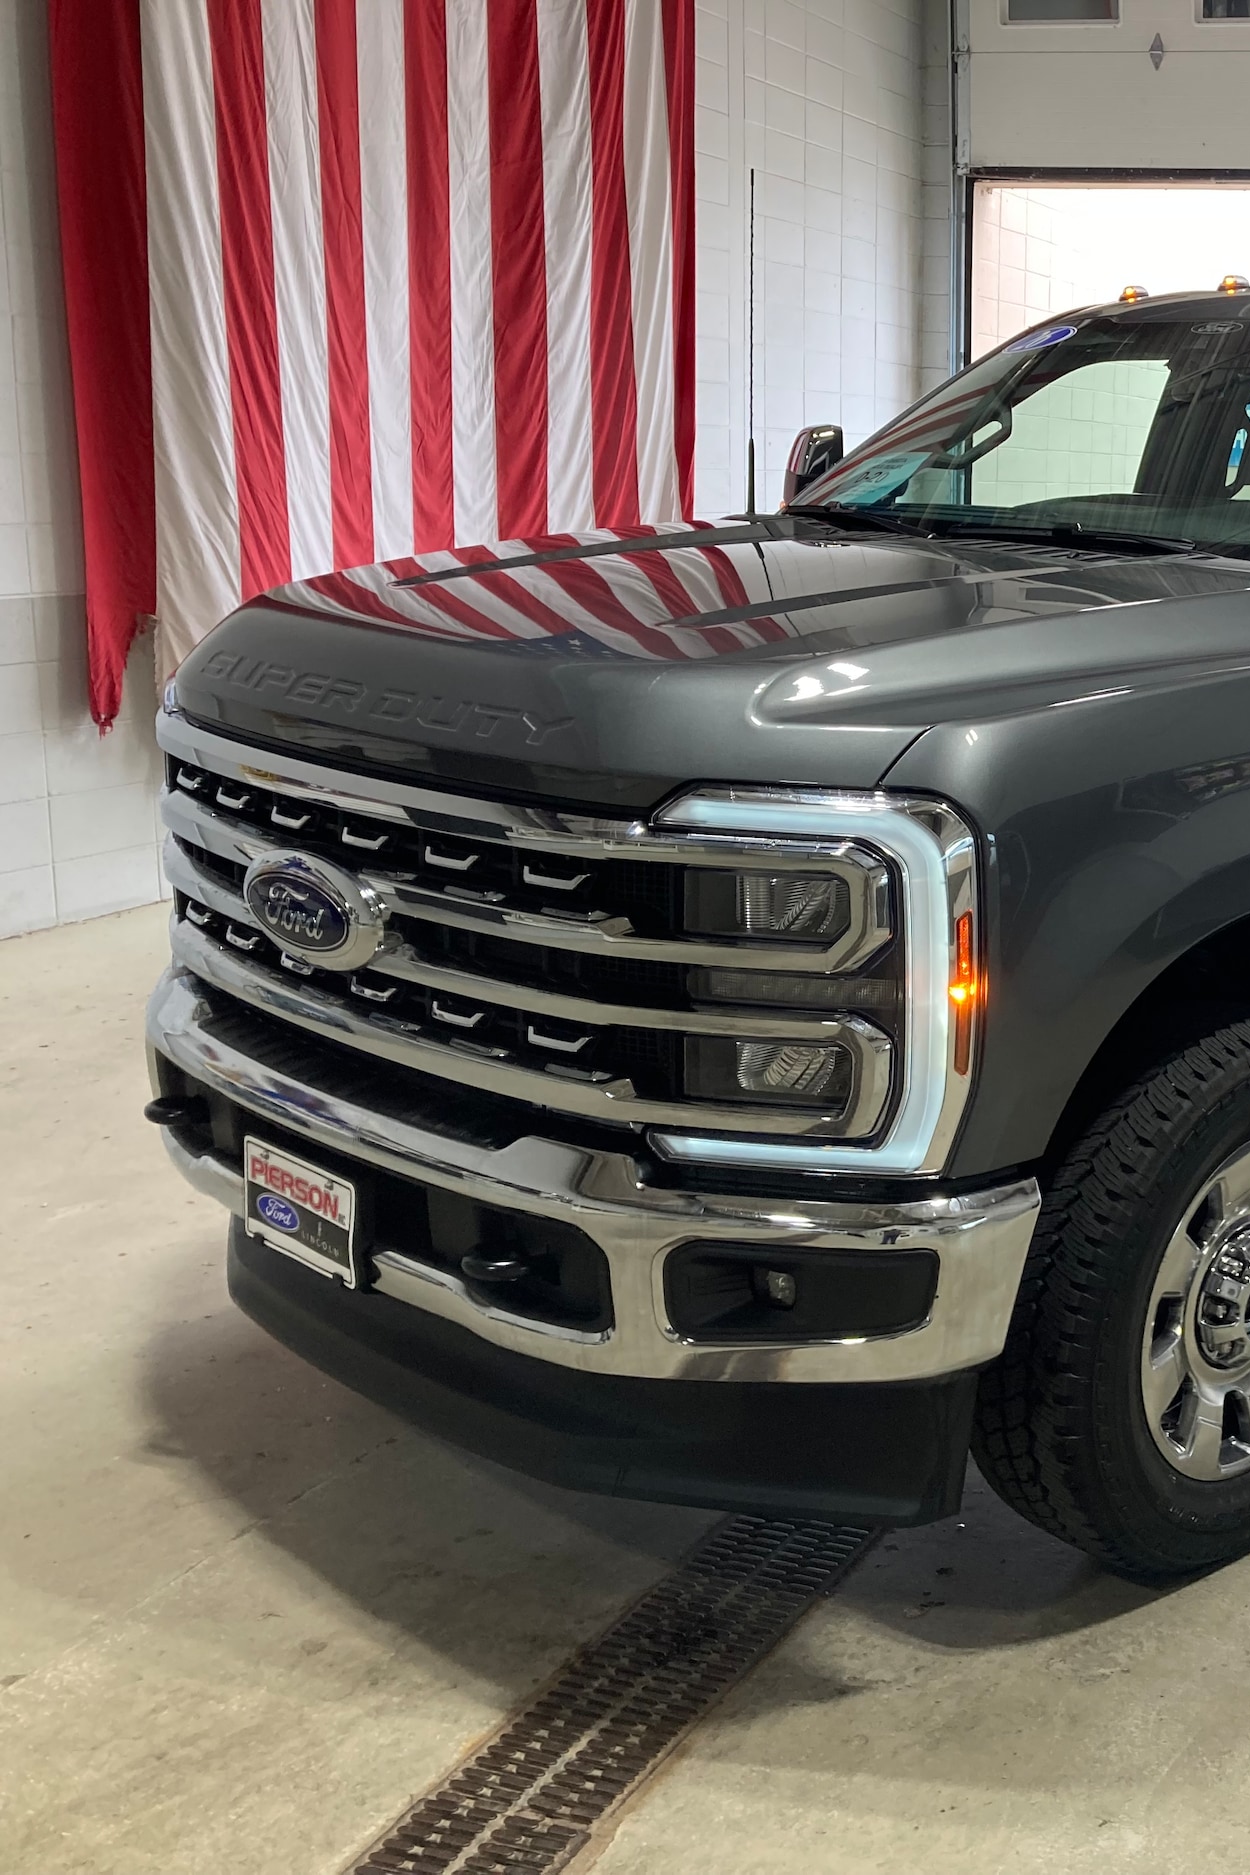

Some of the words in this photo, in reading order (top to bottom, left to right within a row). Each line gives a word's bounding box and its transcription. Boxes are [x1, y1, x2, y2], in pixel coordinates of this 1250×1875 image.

[200, 650, 368, 712] SUPER
[369, 688, 576, 746] DUTY
[264, 881, 325, 941] Ford
[250, 1156, 340, 1221] PIERSON
[265, 1198, 293, 1226] Ford
[301, 1229, 340, 1258] LINCOLN
